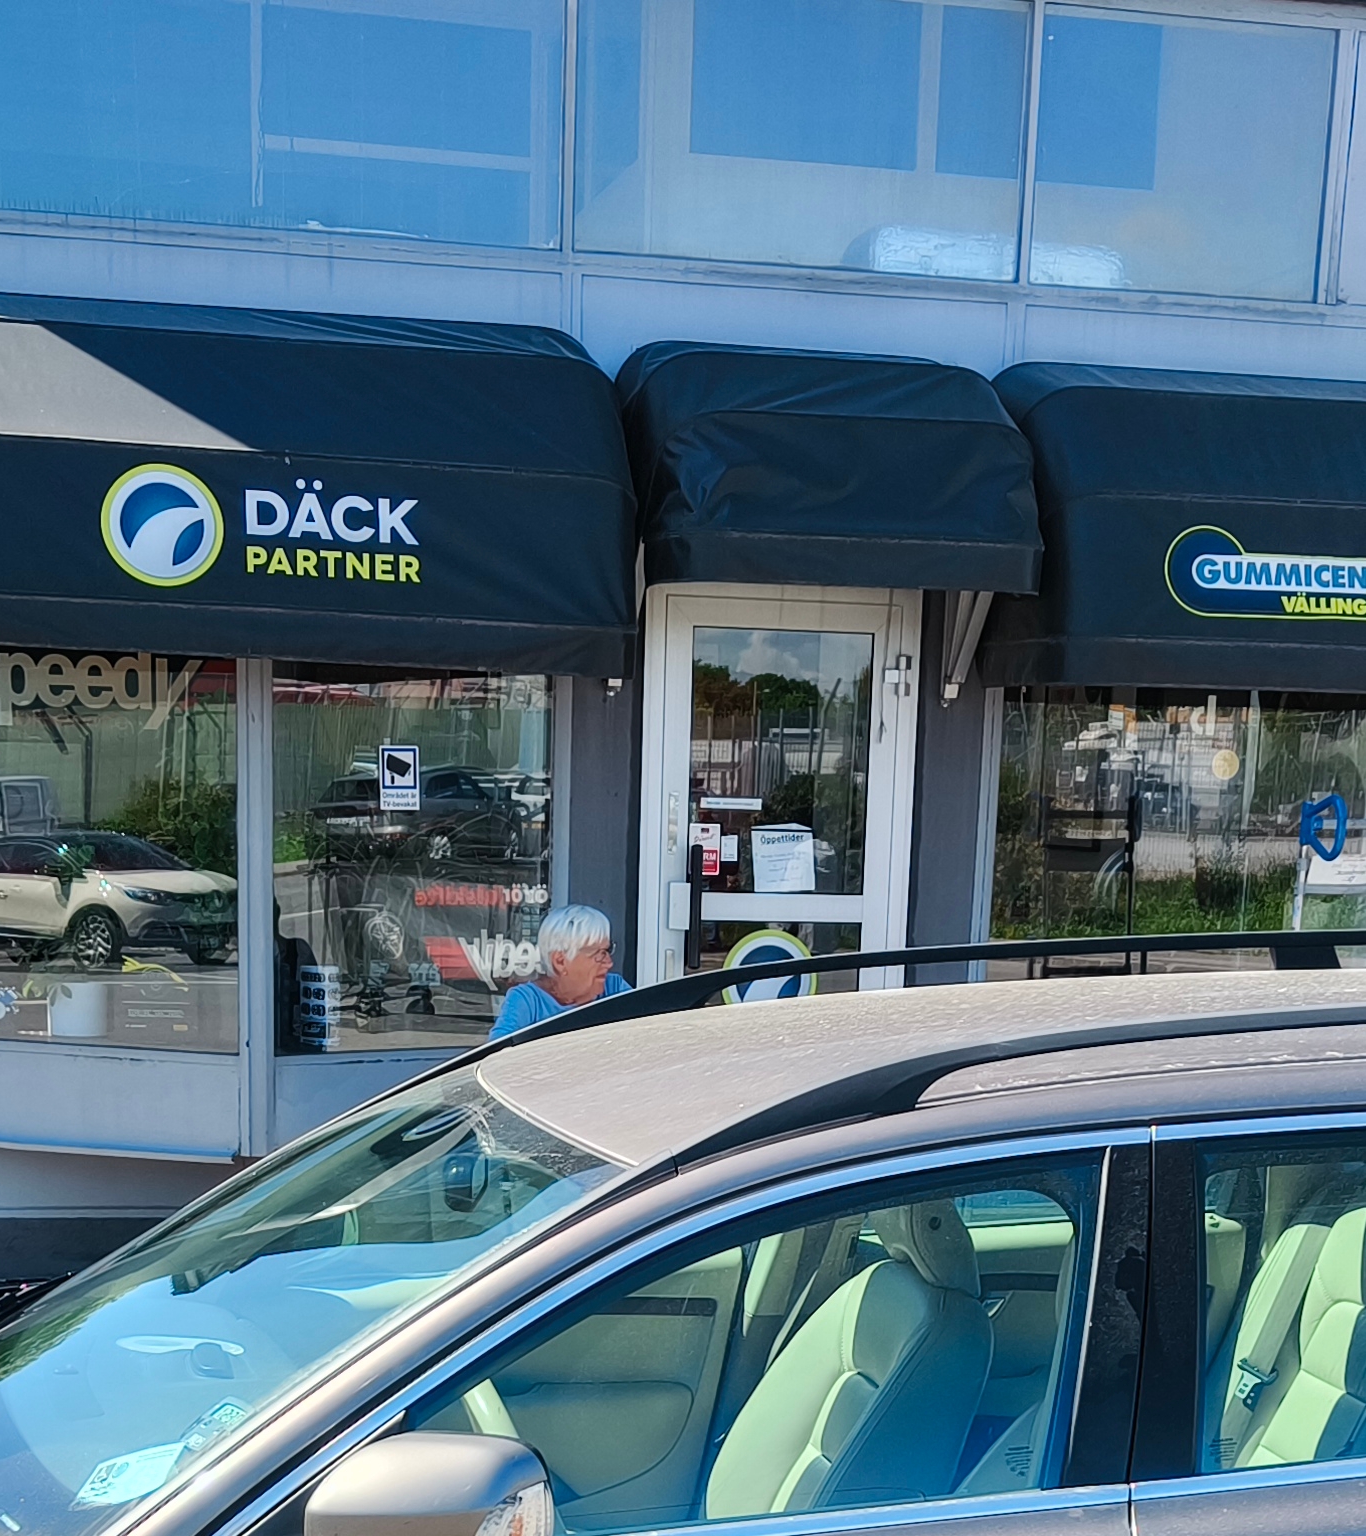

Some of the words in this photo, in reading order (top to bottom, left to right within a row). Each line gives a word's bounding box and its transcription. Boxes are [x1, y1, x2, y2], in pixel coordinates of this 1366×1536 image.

[245, 478, 420, 546] DÄCK
[246, 545, 421, 583] PARTNER
[760, 833, 804, 845] Öppettider
